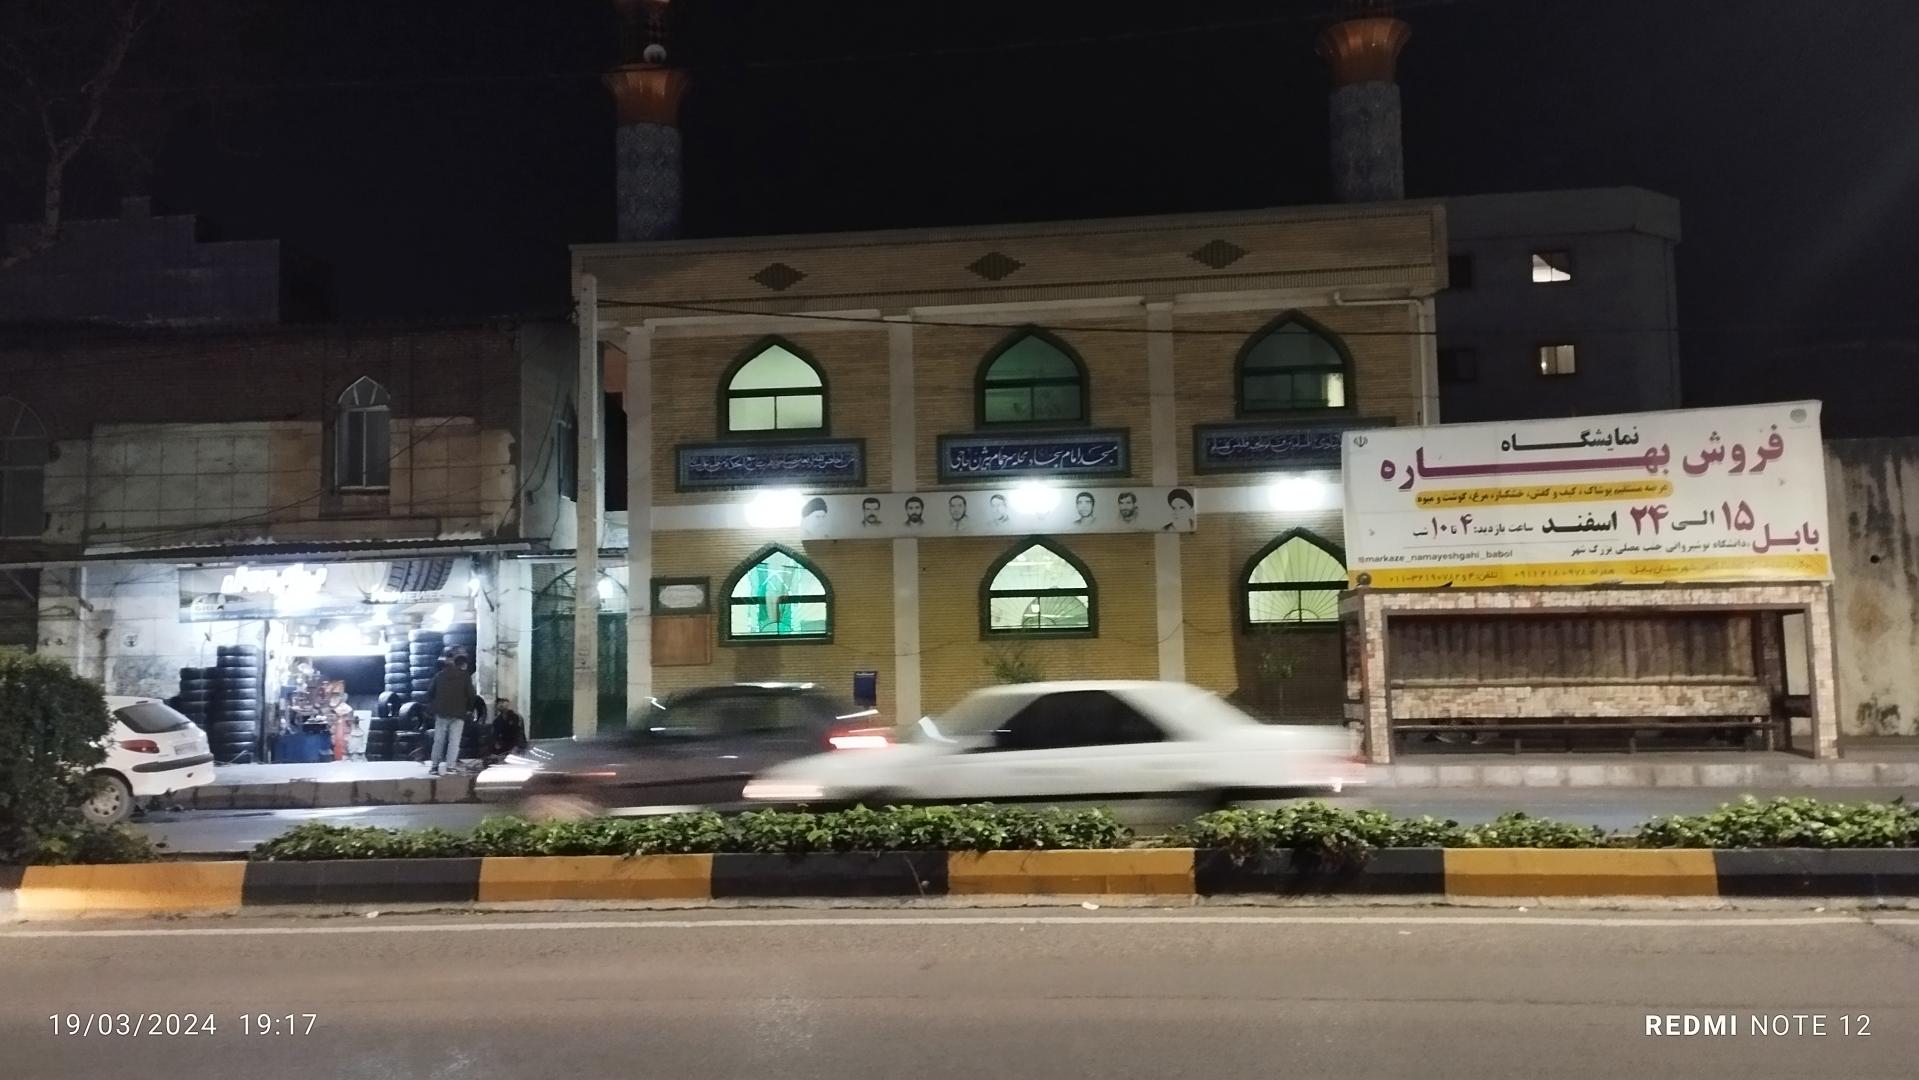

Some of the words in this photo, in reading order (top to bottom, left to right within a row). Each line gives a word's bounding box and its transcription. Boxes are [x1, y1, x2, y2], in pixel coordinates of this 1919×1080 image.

[1501, 425, 1640, 453] نمایشگاه
[1682, 423, 1785, 477] فروش
[1060, 447, 1081, 468] امام
[1077, 445, 1118, 466] مسجد
[1379, 443, 1671, 490] بهاره
[1432, 516, 1448, 537] ۱۰
[1459, 513, 1474, 535] ۴
[1541, 510, 1618, 534] اسفند
[1630, 503, 1670, 537] ۲۴
[1671, 509, 1716, 532] الی
[1721, 499, 1756, 532] ۱۵
[1450, 524, 1458, 535] تا
[1508, 522, 1534, 533] ساعت
[1752, 521, 1820, 555] بابل
